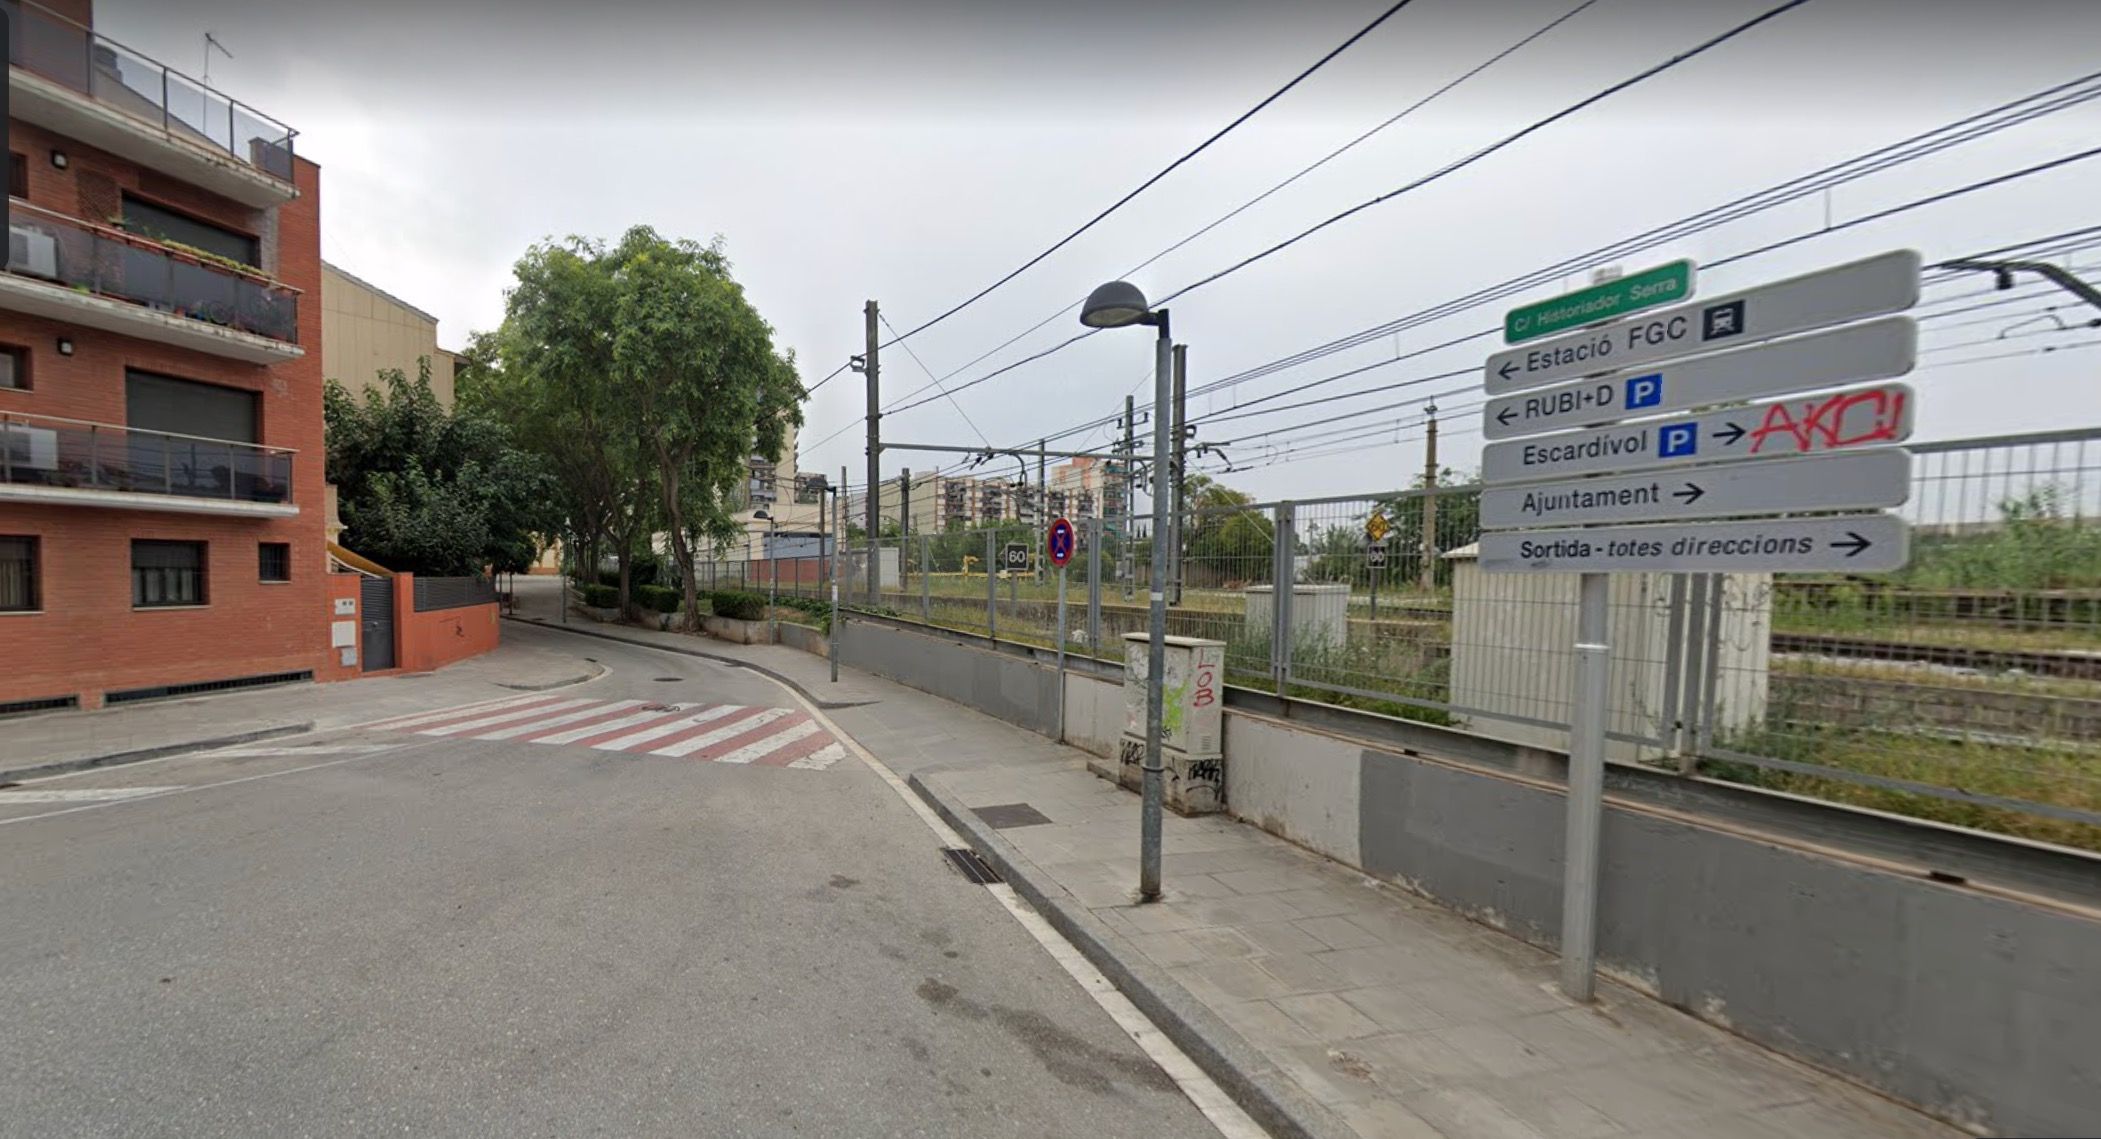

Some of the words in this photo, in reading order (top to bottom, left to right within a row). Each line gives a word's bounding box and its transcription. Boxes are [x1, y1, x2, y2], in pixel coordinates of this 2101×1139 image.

[1537, 294, 1621, 325] Historiador
[1631, 278, 1677, 301] Serra
[1527, 334, 1612, 372] Estació
[1628, 316, 1687, 350] FGC
[1525, 384, 1615, 420] RUBI+D
[1522, 430, 1648, 466] Escardívol
[1521, 482, 1660, 517] Ajuntament
[1009, 550, 1025, 563] 60
[1520, 539, 1591, 560] Sortida
[1608, 537, 1662, 557] totes
[1671, 533, 1813, 555] direccions
